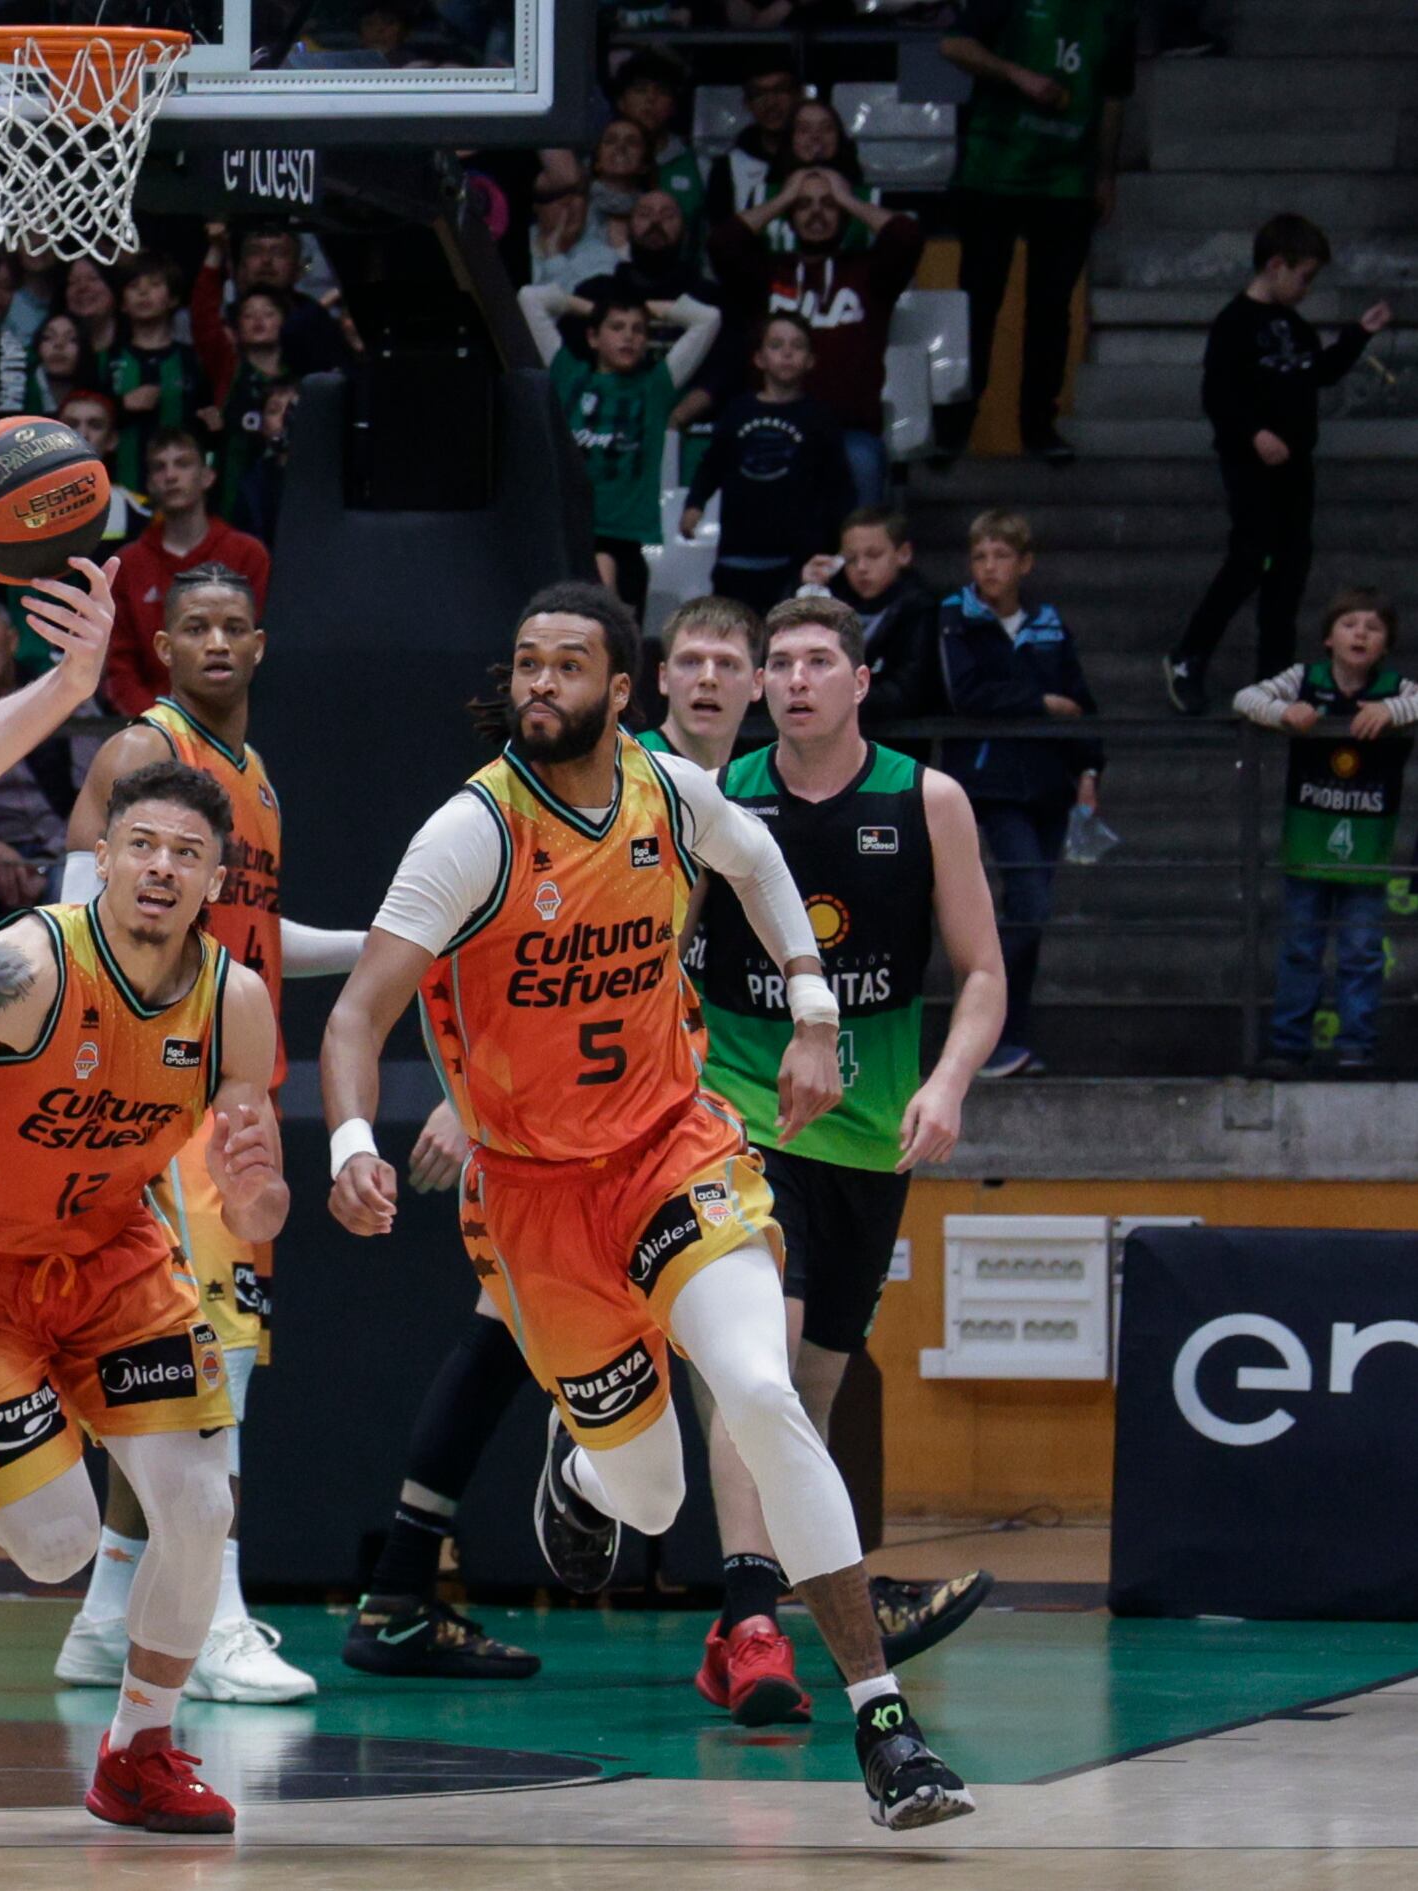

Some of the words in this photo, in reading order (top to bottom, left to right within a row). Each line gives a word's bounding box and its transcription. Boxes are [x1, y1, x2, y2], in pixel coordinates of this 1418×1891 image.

[1055, 37, 1081, 74] 16
[13, 472, 97, 518] LEGACY
[1327, 817, 1354, 860] 4
[244, 925, 265, 970] 4
[515, 916, 653, 966] Cultura
[746, 952, 892, 970] FUCIÓN
[746, 968, 891, 1010] PRITAS
[576, 1019, 628, 1085] 5
[18, 1114, 151, 1150] Esfue
[56, 1172, 112, 1220] 12
[697, 1184, 722, 1201] acb
[634, 1218, 697, 1277] Midea
[111, 1361, 195, 1392] Midea
[563, 1350, 647, 1400] PULEVA
